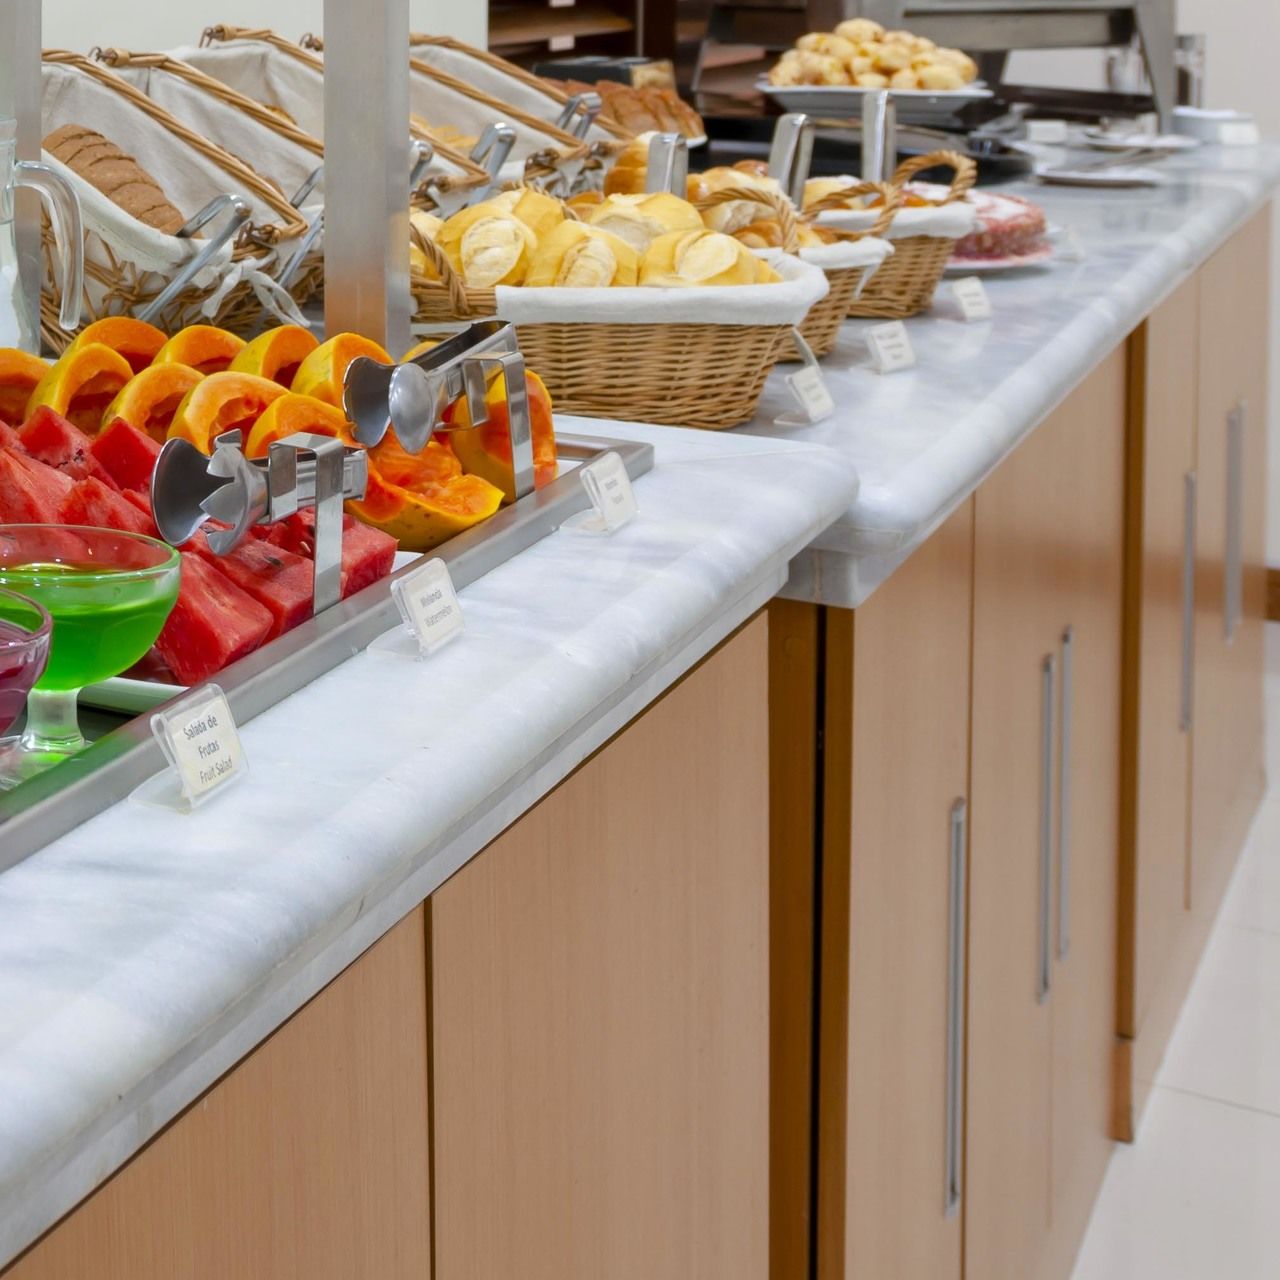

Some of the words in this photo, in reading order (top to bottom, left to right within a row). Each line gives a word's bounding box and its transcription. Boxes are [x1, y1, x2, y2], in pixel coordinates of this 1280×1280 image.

[183, 720, 208, 741] Salada
[207, 713, 219, 730] de
[198, 740, 220, 759] Frutas
[199, 765, 217, 785] Fruit
[215, 755, 233, 777] Salad
